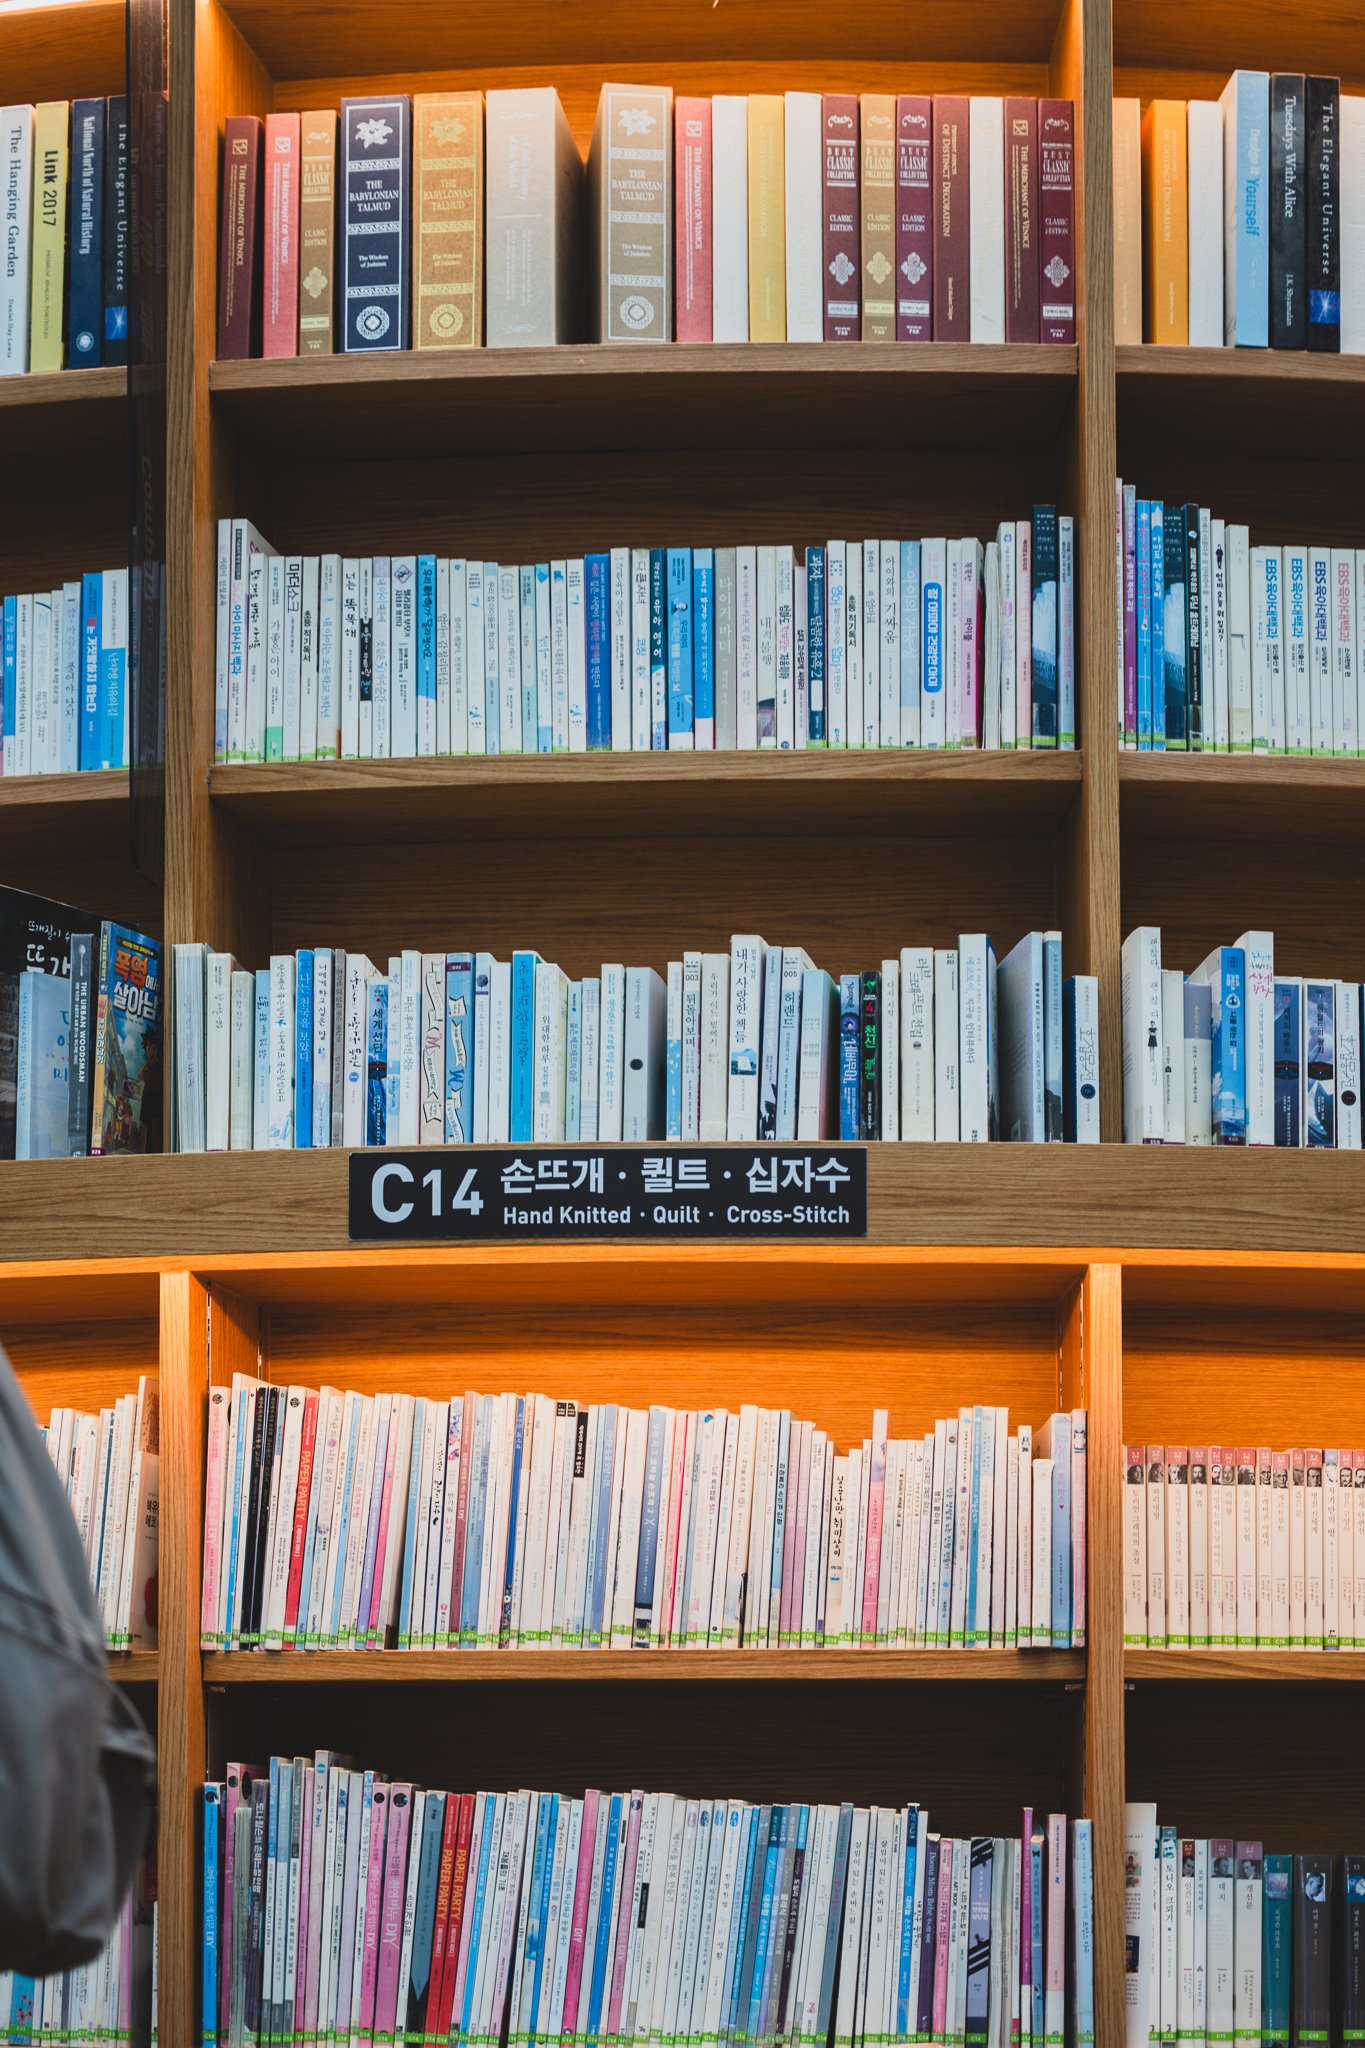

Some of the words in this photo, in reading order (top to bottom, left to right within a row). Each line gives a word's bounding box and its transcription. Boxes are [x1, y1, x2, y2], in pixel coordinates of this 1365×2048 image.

[942, 124, 949, 136] OF
[1283, 96, 1295, 149] Tuesdays
[1323, 104, 1332, 131] The
[10, 126, 22, 153] The
[83, 116, 95, 151] National
[118, 123, 126, 149] The
[1248, 128, 1260, 164] Design
[43, 151, 58, 184] Link
[82, 153, 94, 177] North
[239, 164, 247, 180] THE
[827, 157, 855, 170] CLASSIC
[900, 156, 927, 170] CLASSIC
[942, 138, 950, 178] DISTINCT
[1043, 160, 1071, 173] CLASSIC
[1285, 153, 1296, 183] With
[1320, 139, 1332, 197] Elegant
[82, 178, 93, 186] of
[116, 157, 126, 213] Elegant
[366, 180, 383, 190] THE
[612, 180, 663, 190] BABYLONIAN
[629, 170, 645, 178] THE
[5, 160, 21, 220] Hanging
[81, 188, 93, 220] Natural
[238, 182, 246, 224] MERCHANT
[349, 190, 399, 201] BABYLONIAN
[620, 192, 654, 201] TALMUD
[1285, 189, 1296, 218] Alice
[42, 190, 57, 226] 2017
[357, 202, 391, 211] TALMUD
[1022, 208, 1029, 218] OF
[1246, 178, 1259, 236] Yourself
[830, 224, 853, 232] EDITION
[1045, 218, 1068, 226] CLASSIC
[1045, 227, 1068, 235] EDITION
[7, 226, 20, 277] Garden
[79, 222, 93, 254] History
[236, 238, 244, 266] VENICE
[1323, 204, 1332, 275] Universe
[116, 221, 126, 291] Universe
[1285, 288, 1293, 326] Shyamalan
[287, 563, 299, 613] 마더쇼크
[928, 589, 938, 599] 잘
[928, 602, 938, 633] 아파야
[928, 636, 938, 665] 건강한
[87, 684, 96, 712] 않는다
[78, 1031, 86, 1082] WOODSMAN
[501, 1158, 604, 1194] 손뜨개
[641, 1157, 709, 1192] 퀼트
[746, 1157, 850, 1193] 십자수
[372, 1163, 483, 1223] C14
[504, 1207, 552, 1225] Hand
[560, 1206, 631, 1224] Knitted
[653, 1206, 700, 1225] Quilt
[727, 1205, 850, 1224] Cross-Stitch
[300, 1450, 311, 1484] PAPER
[297, 1486, 308, 1520] PARTY
[439, 1849, 452, 1883] PAPER
[453, 1849, 467, 1883] PAPER
[928, 1852, 936, 1876] Doona
[436, 1885, 450, 1919] PARTY
[450, 1885, 464, 1919] PARTY
[383, 1923, 400, 1949] DIY
